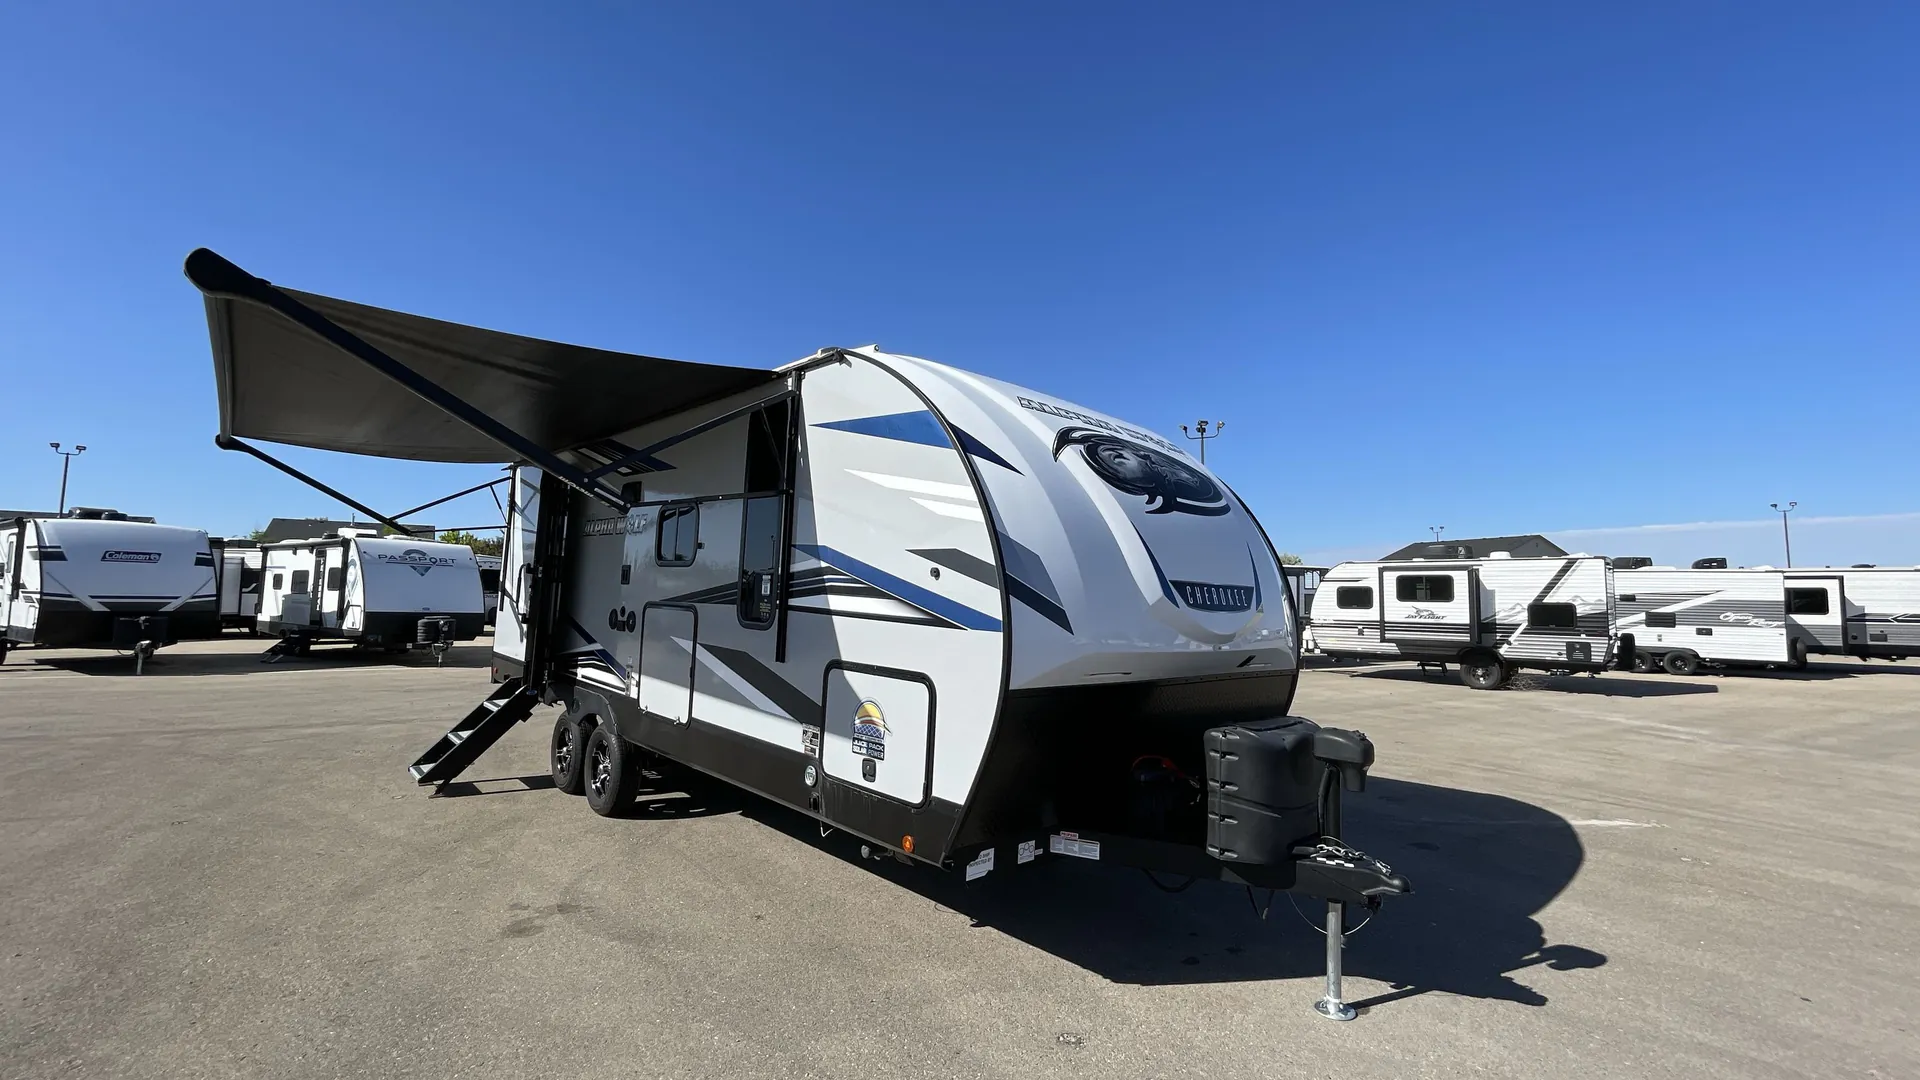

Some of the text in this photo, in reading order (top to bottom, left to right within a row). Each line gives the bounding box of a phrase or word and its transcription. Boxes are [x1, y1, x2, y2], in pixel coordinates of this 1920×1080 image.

[1017, 396, 1123, 434] ALPHA
[583, 513, 648, 536] ALPHA WOLF
[105, 551, 149, 560] Coleman
[378, 554, 457, 564] PASSPORT
[1186, 585, 1247, 606] CHEROKEE
[853, 739, 884, 752] JUICE PACK
[868, 749, 884, 759] POWER
